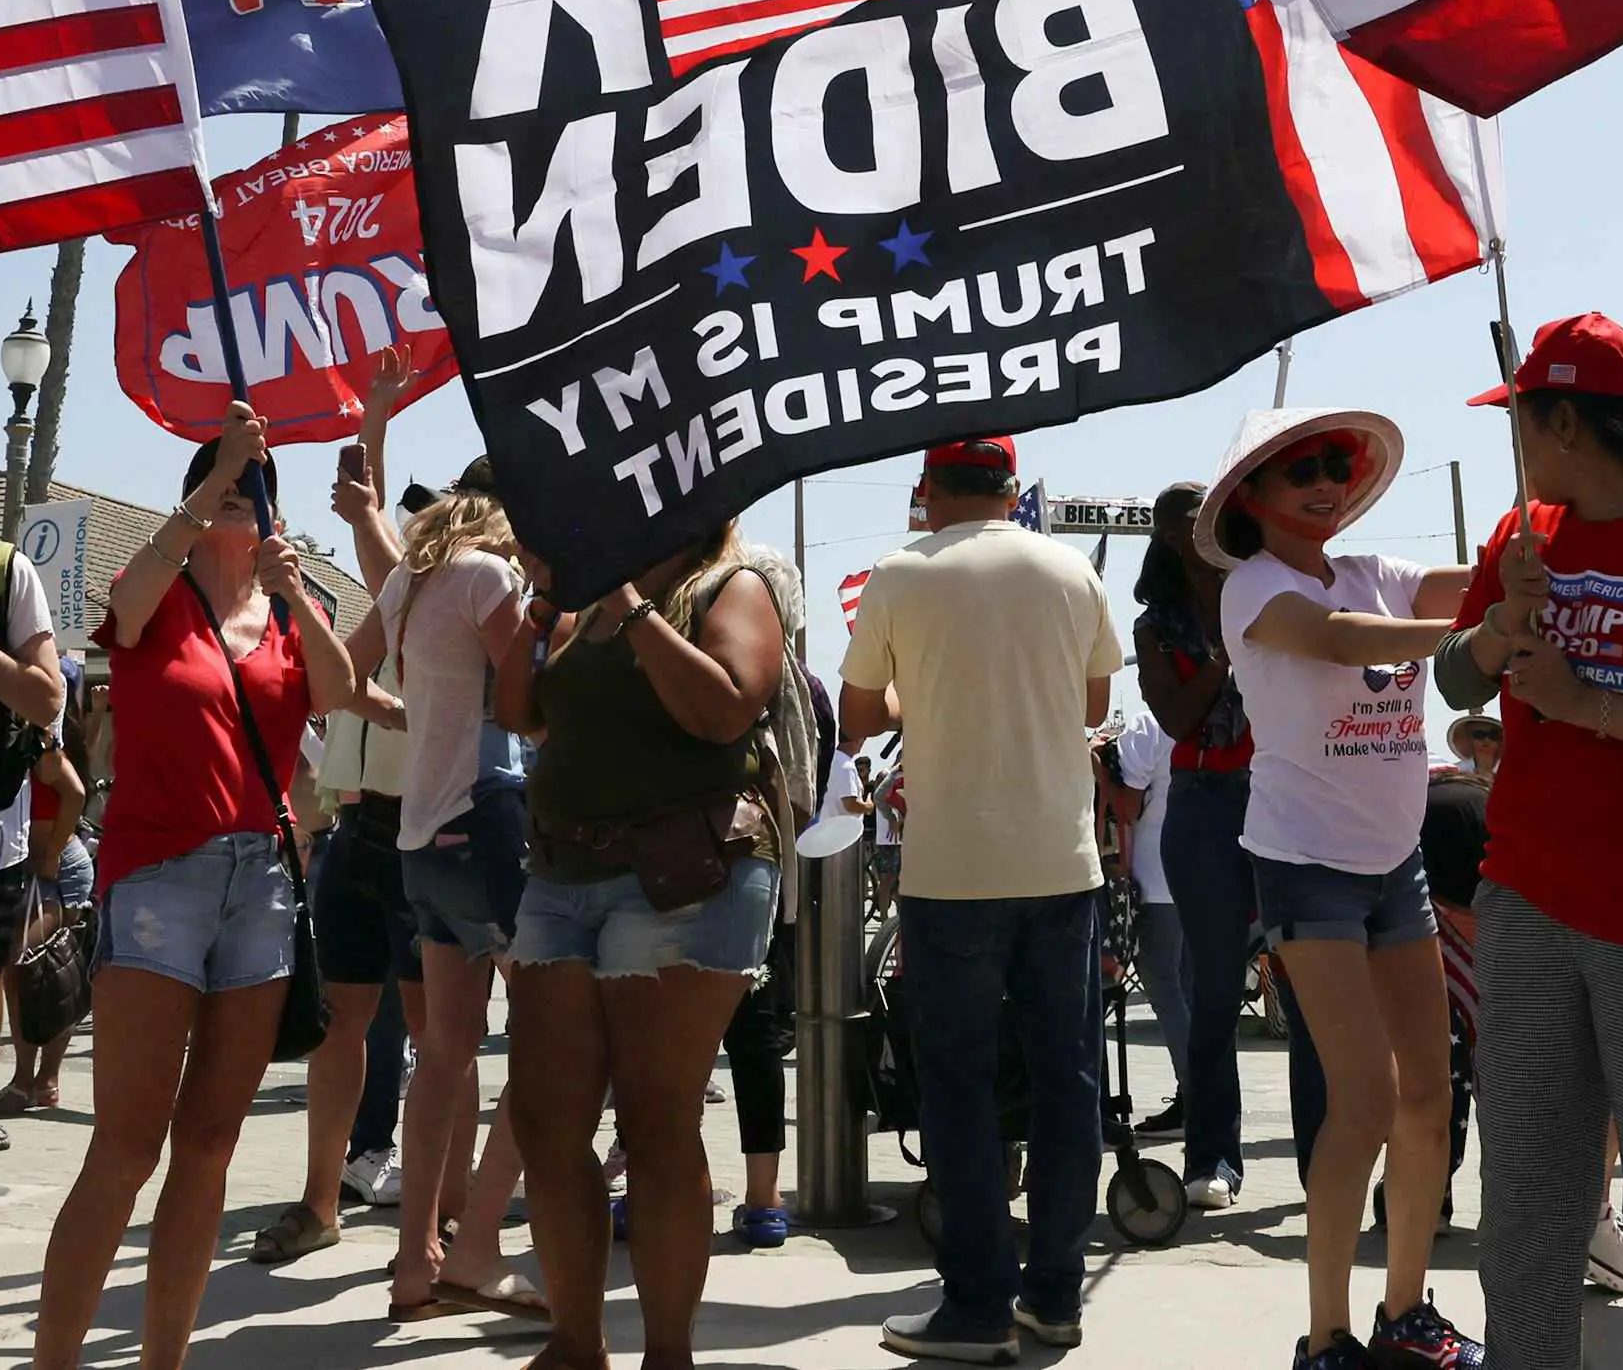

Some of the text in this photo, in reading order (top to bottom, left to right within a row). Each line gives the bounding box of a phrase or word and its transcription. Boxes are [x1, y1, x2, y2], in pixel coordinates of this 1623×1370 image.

[236, 148, 412, 208] MERICA GREAT
[291, 192, 385, 246] 2024
[159, 253, 446, 386] RUMP
[1064, 504, 1152, 526] BIER FES
[60, 568, 71, 631] VISITOR
[73, 516, 88, 630] INFORMATION
[1325, 714, 1424, 741] Trump Gir
[1352, 698, 1412, 716] I'm Still A
[1333, 742, 1369, 756] Make
[1370, 741, 1386, 754] No
